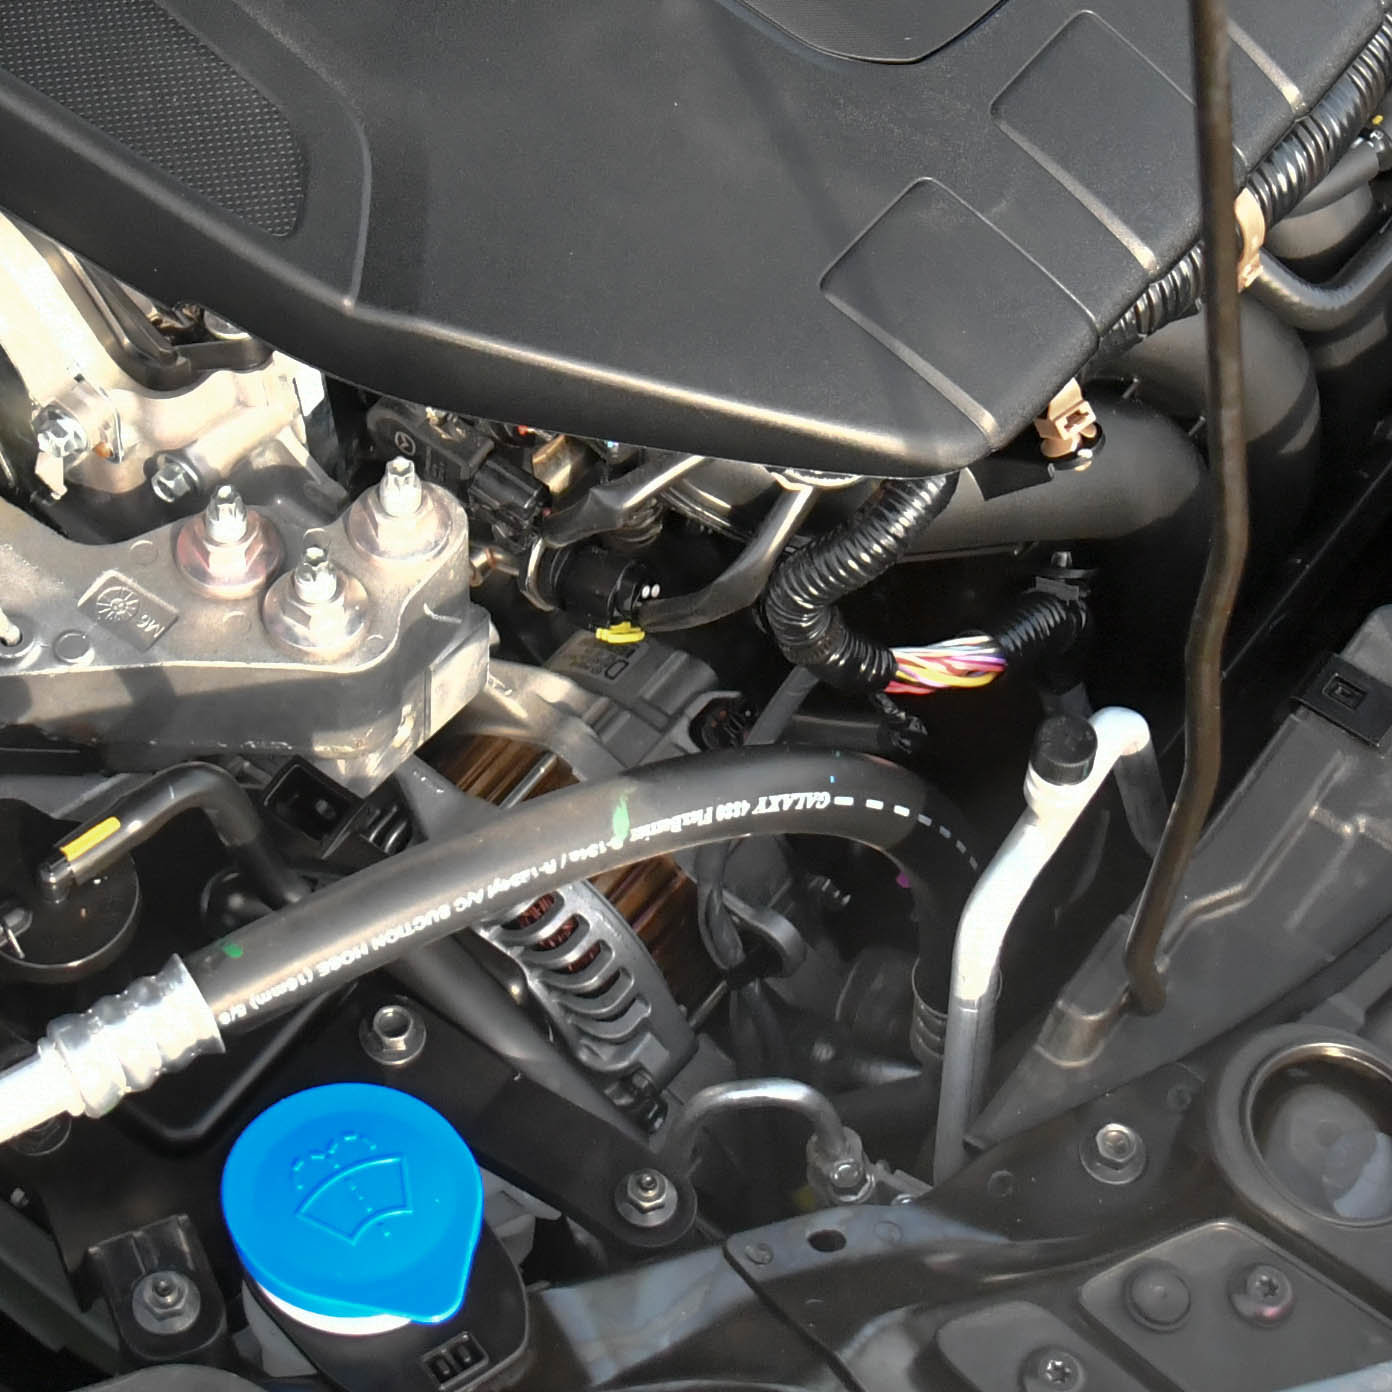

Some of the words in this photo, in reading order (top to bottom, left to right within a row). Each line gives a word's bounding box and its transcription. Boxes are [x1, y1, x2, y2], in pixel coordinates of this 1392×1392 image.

[752, 791, 831, 815] GALAXY
[371, 904, 451, 951] SUCTION
[315, 943, 369, 977] HOSE
